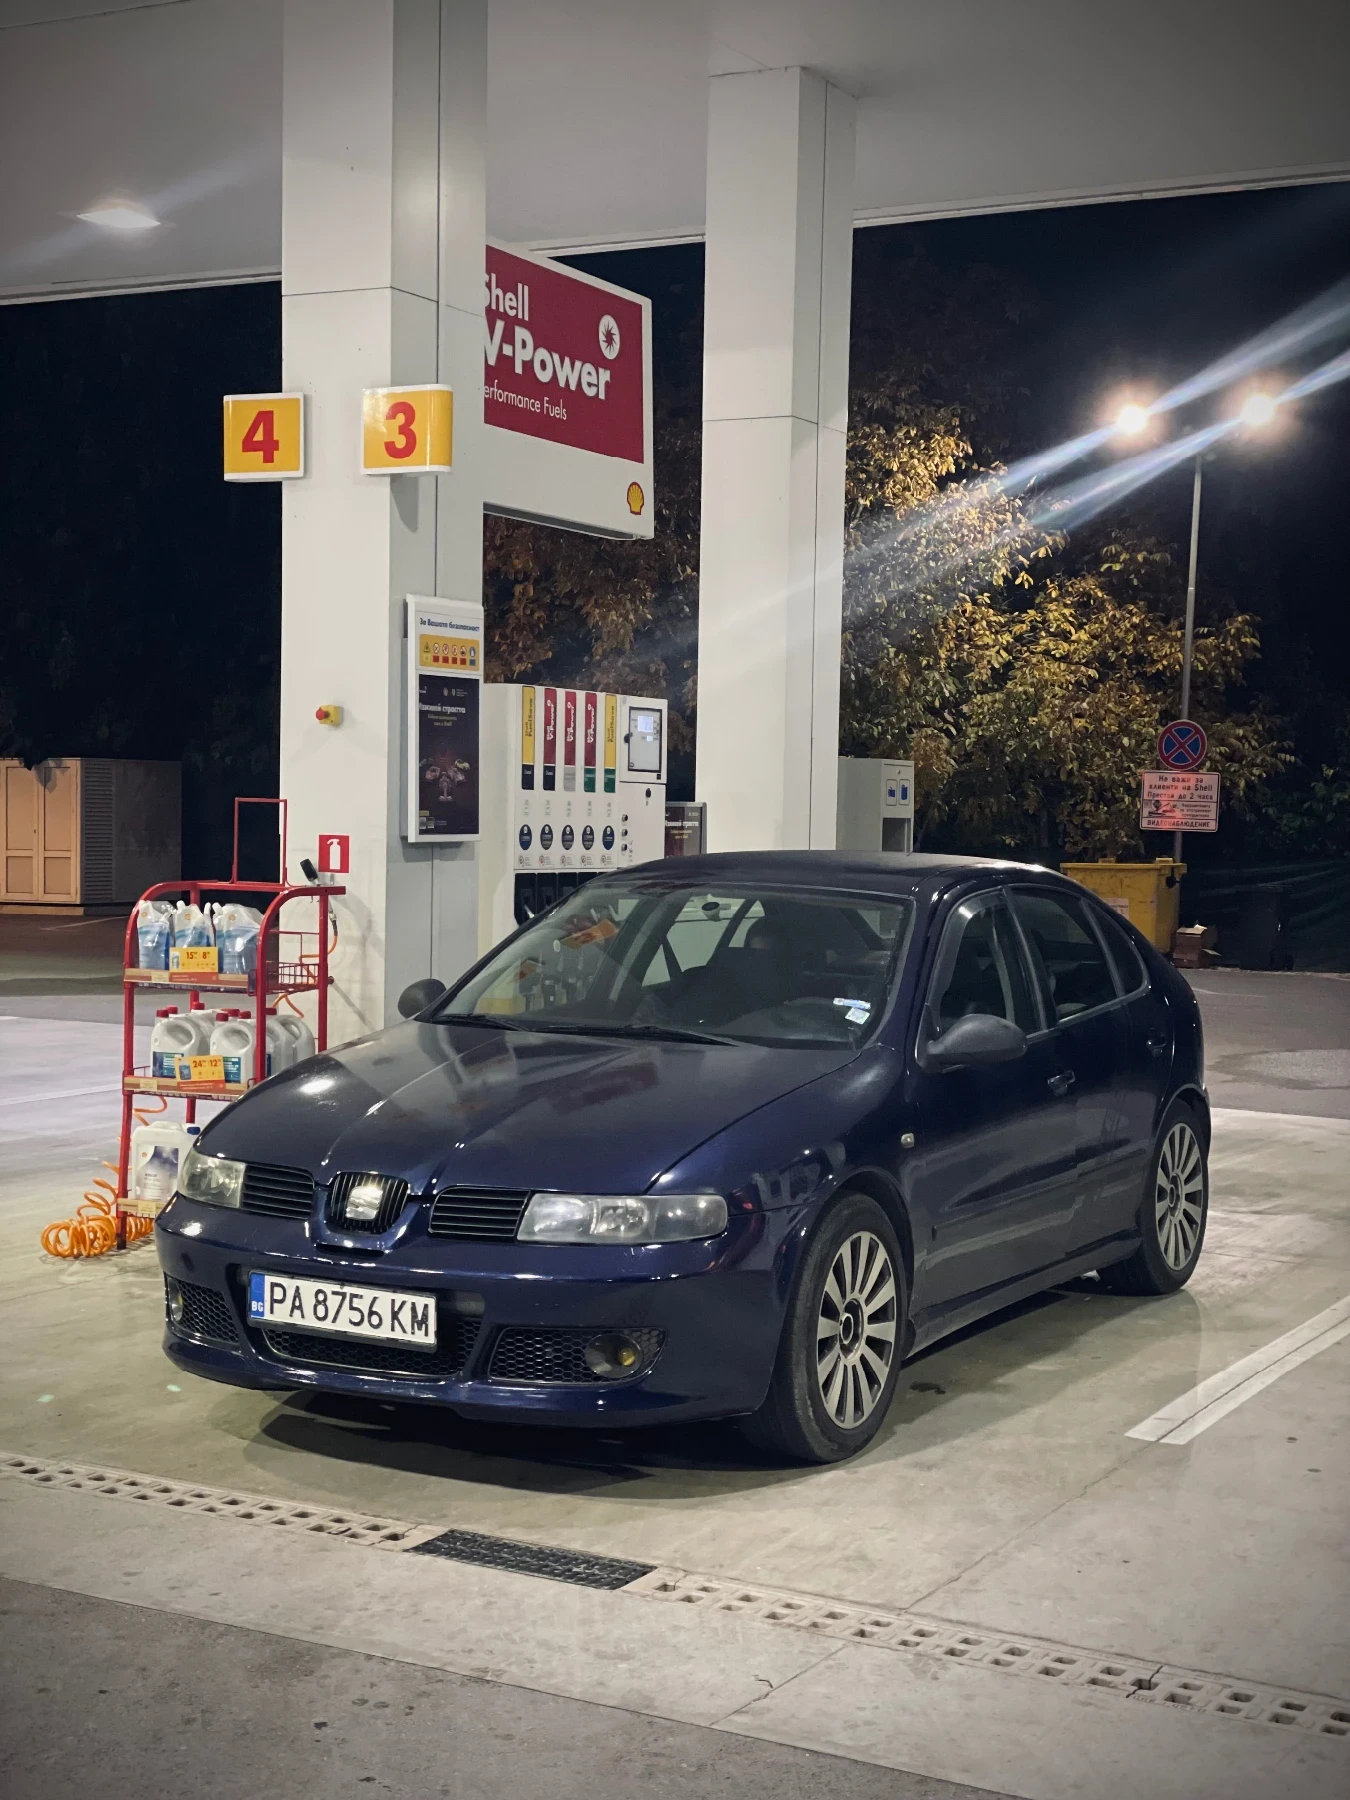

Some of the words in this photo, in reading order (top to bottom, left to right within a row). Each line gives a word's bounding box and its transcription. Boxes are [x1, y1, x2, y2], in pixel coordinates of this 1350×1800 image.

[484, 272, 529, 321] Shell
[484, 317, 611, 401] V-Power
[484, 379, 541, 413] erformance
[543, 396, 567, 420] Fuels
[241, 410, 280, 464] 4
[383, 401, 418, 459] 3
[251, 1301, 264, 1312] BG
[313, 1288, 383, 1330] 8756
